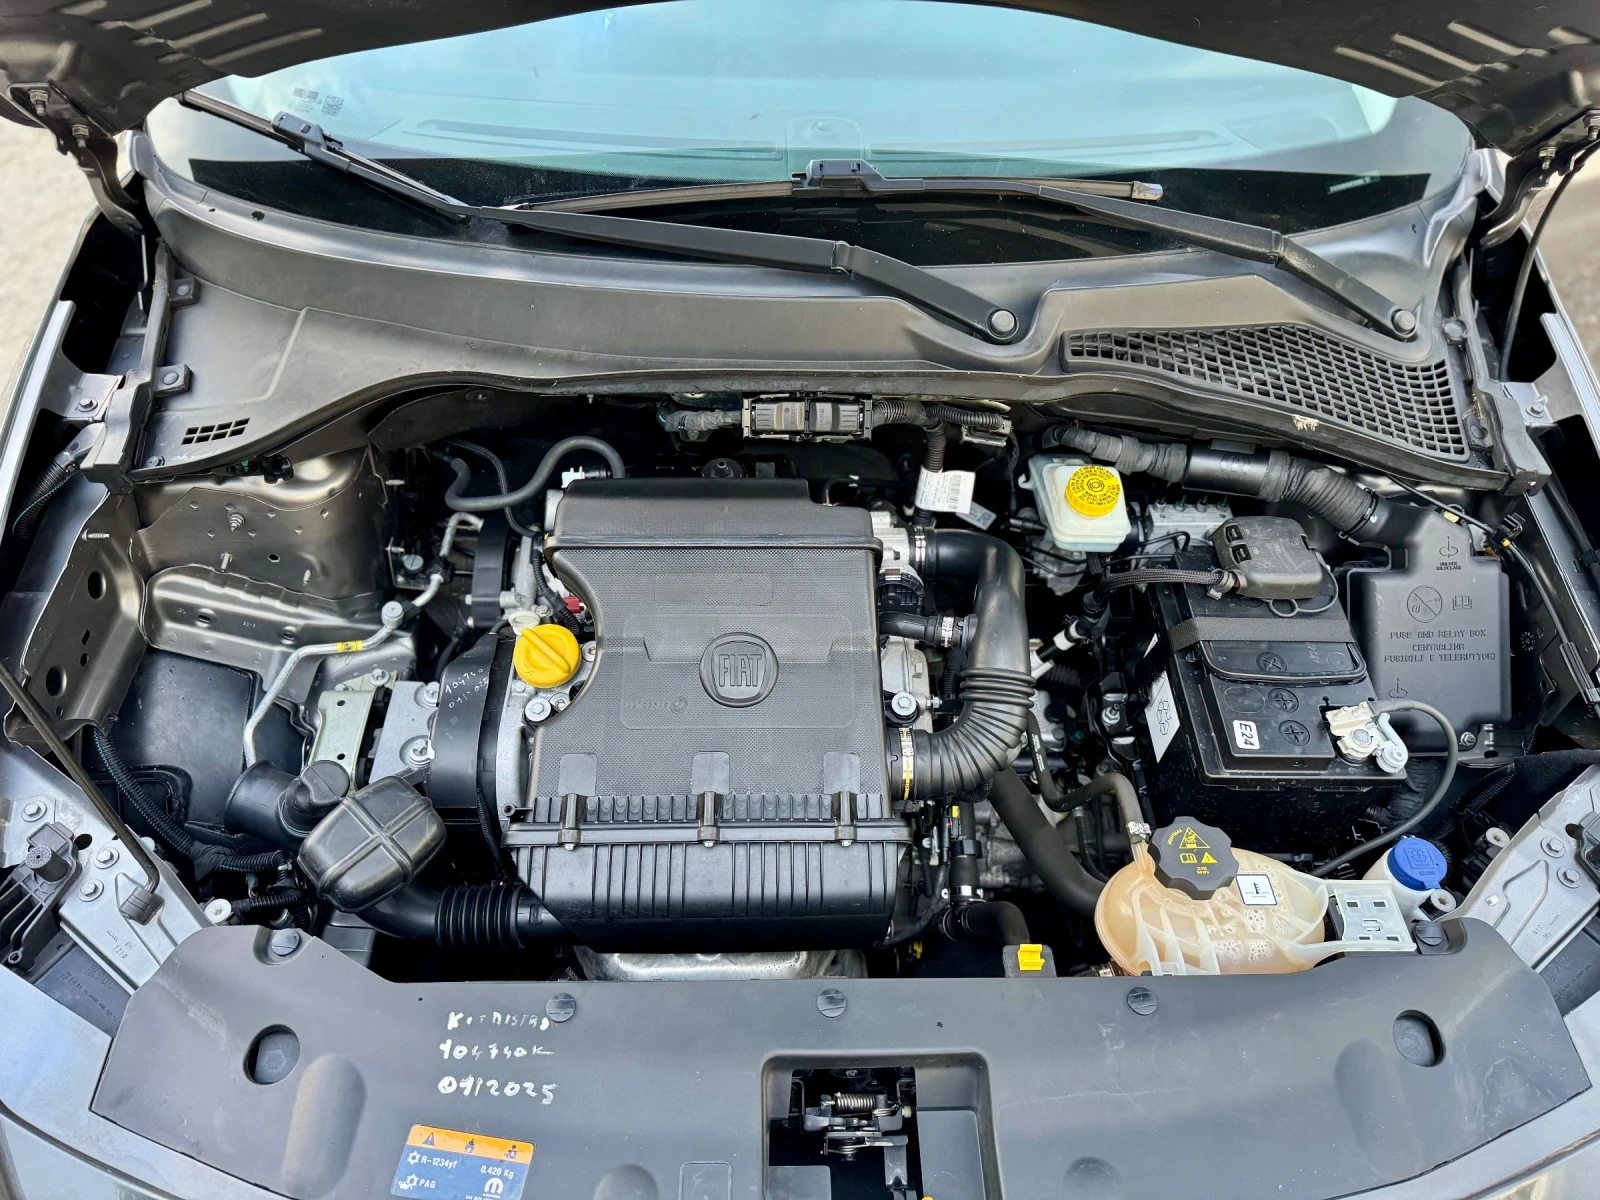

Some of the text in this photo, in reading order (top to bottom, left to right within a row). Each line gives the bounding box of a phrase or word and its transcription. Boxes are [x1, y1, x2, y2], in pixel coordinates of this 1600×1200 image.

[1390, 629, 1487, 640] FUSE AND RELAY BOX
[1412, 642, 1465, 652] CENTRALINA
[1384, 652, 1496, 663] FUSIBILI E TELERUTTORI
[718, 653, 763, 687] FIAT
[420, 1155, 458, 1170] R-1234yf
[480, 1164, 515, 1180] 0.420 Kg
[418, 1178, 437, 1190] PAG
